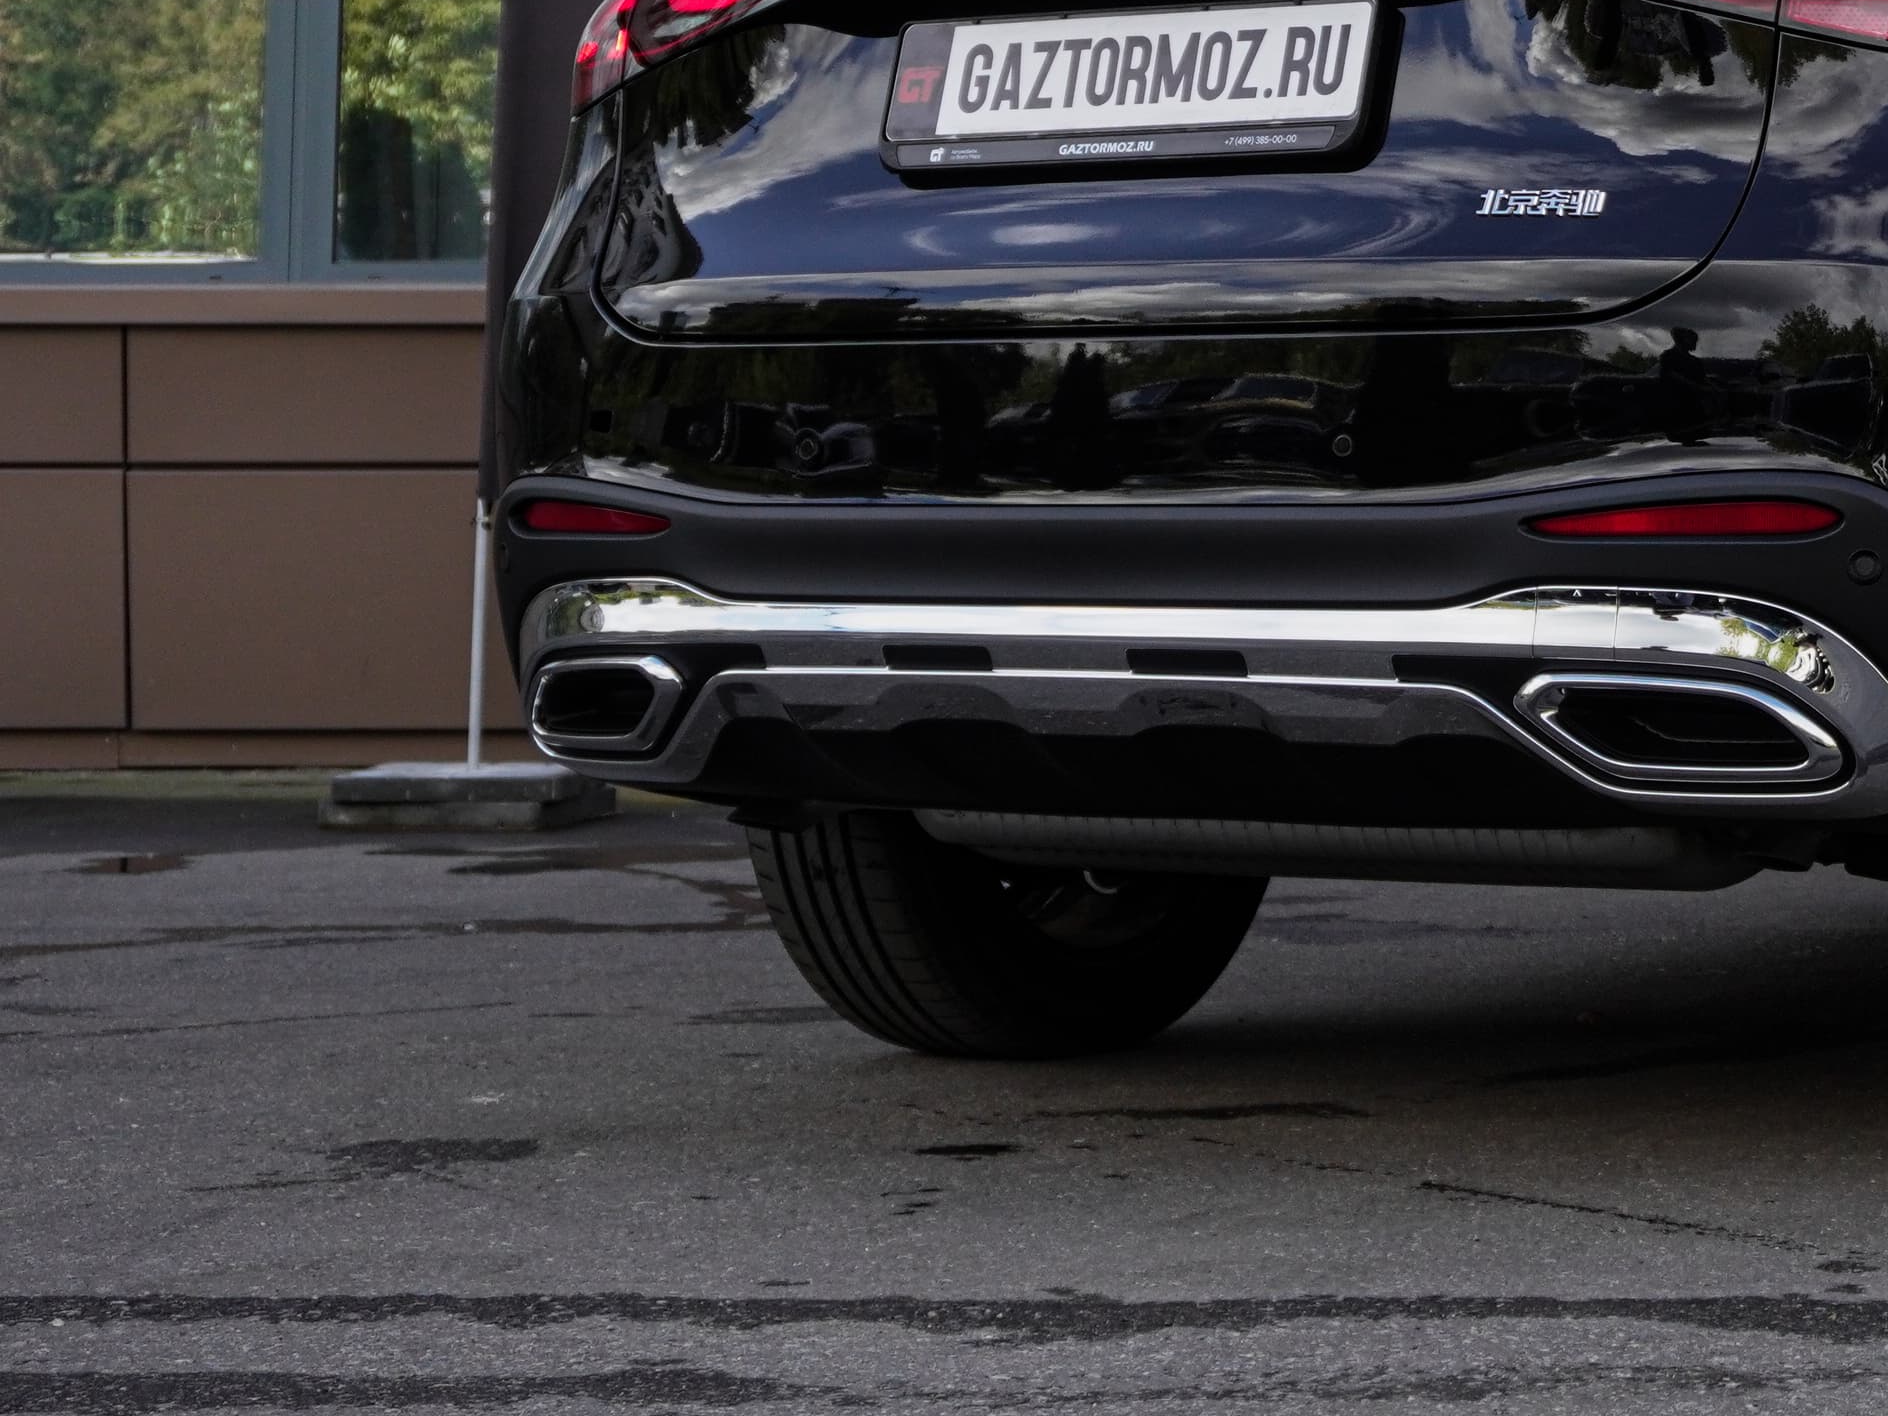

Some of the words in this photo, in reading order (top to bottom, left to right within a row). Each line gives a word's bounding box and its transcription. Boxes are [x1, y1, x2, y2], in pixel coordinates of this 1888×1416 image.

[957, 24, 1353, 114] GAZTORMOZ.RU
[1058, 141, 1155, 156] GAZTORMOZ.RU
[1475, 188, 1607, 217] 北京奔驰
